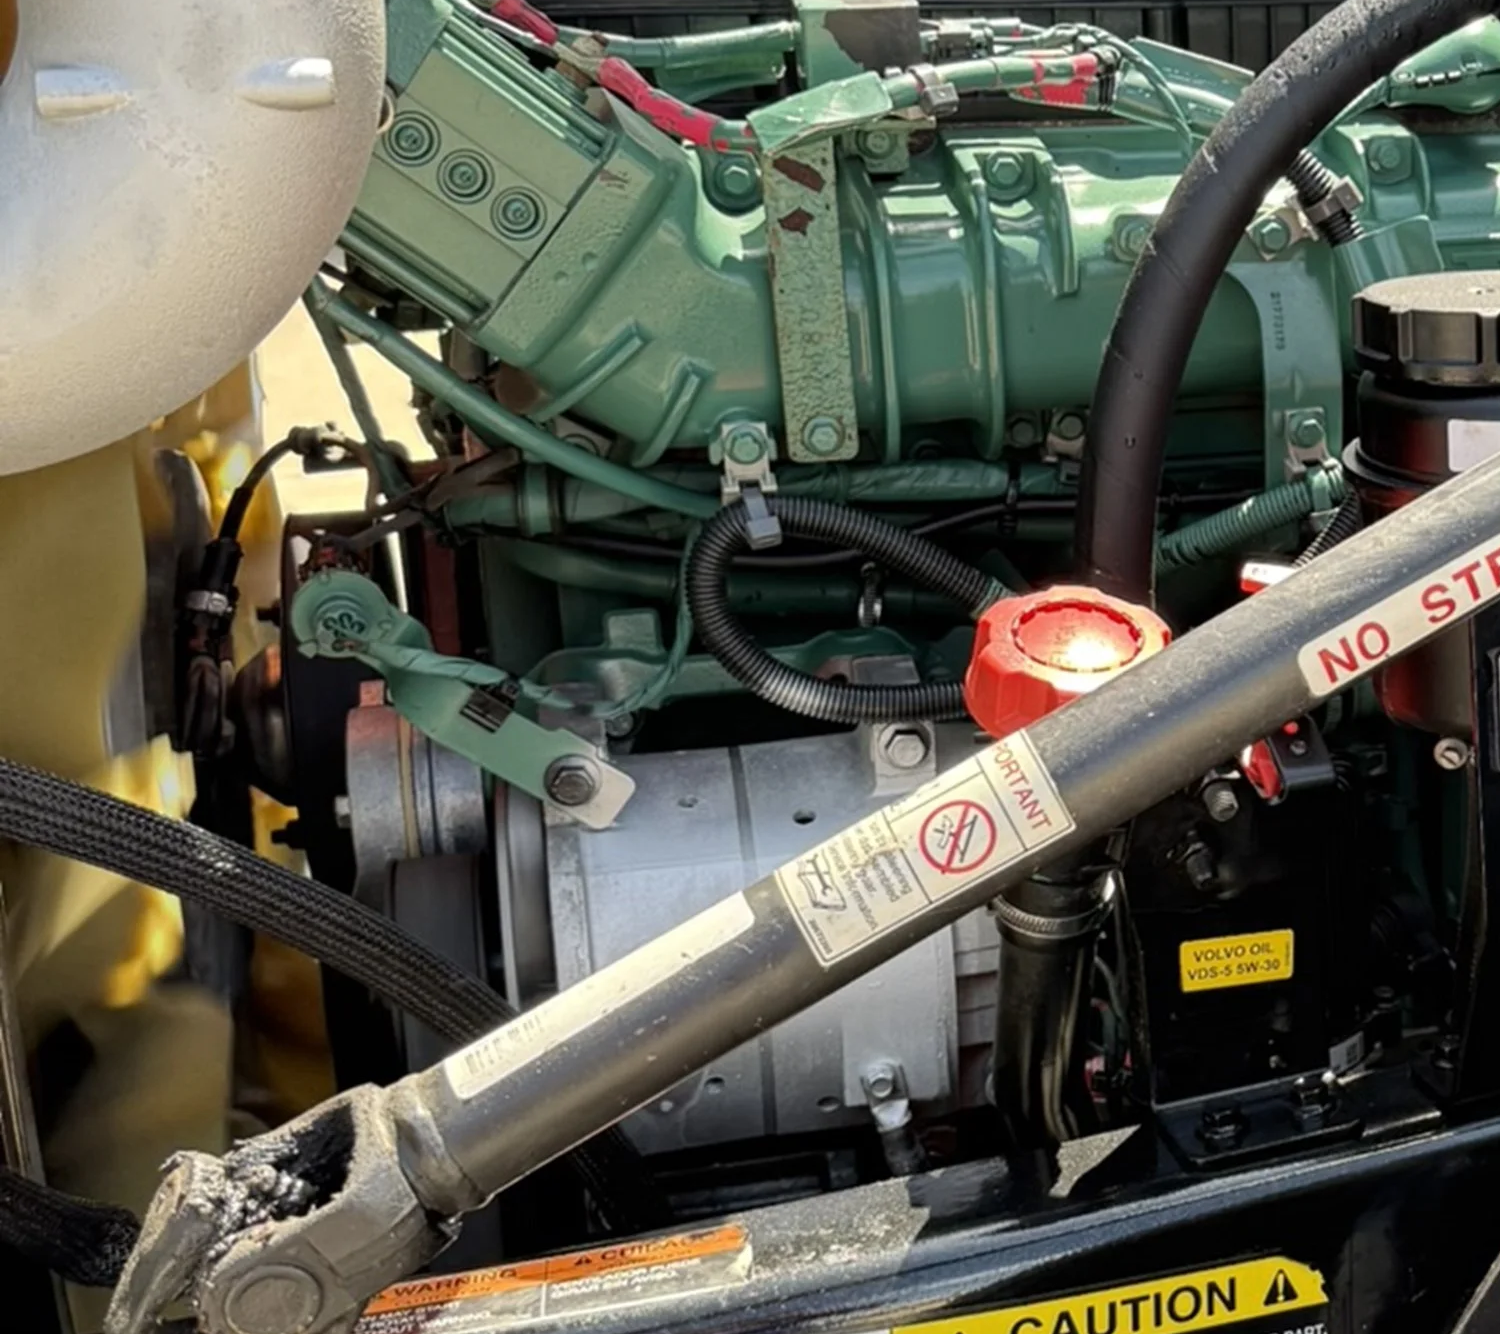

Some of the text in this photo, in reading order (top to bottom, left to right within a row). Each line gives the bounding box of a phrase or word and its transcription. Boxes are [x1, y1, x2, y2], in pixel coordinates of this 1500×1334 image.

[1317, 620, 1391, 684] NO
[1192, 944, 1245, 964] VOLVO
[1249, 942, 1274, 957] OIL
[1186, 958, 1281, 982] VDS-5 5W-30
[394, 1268, 518, 1297] WARNING
